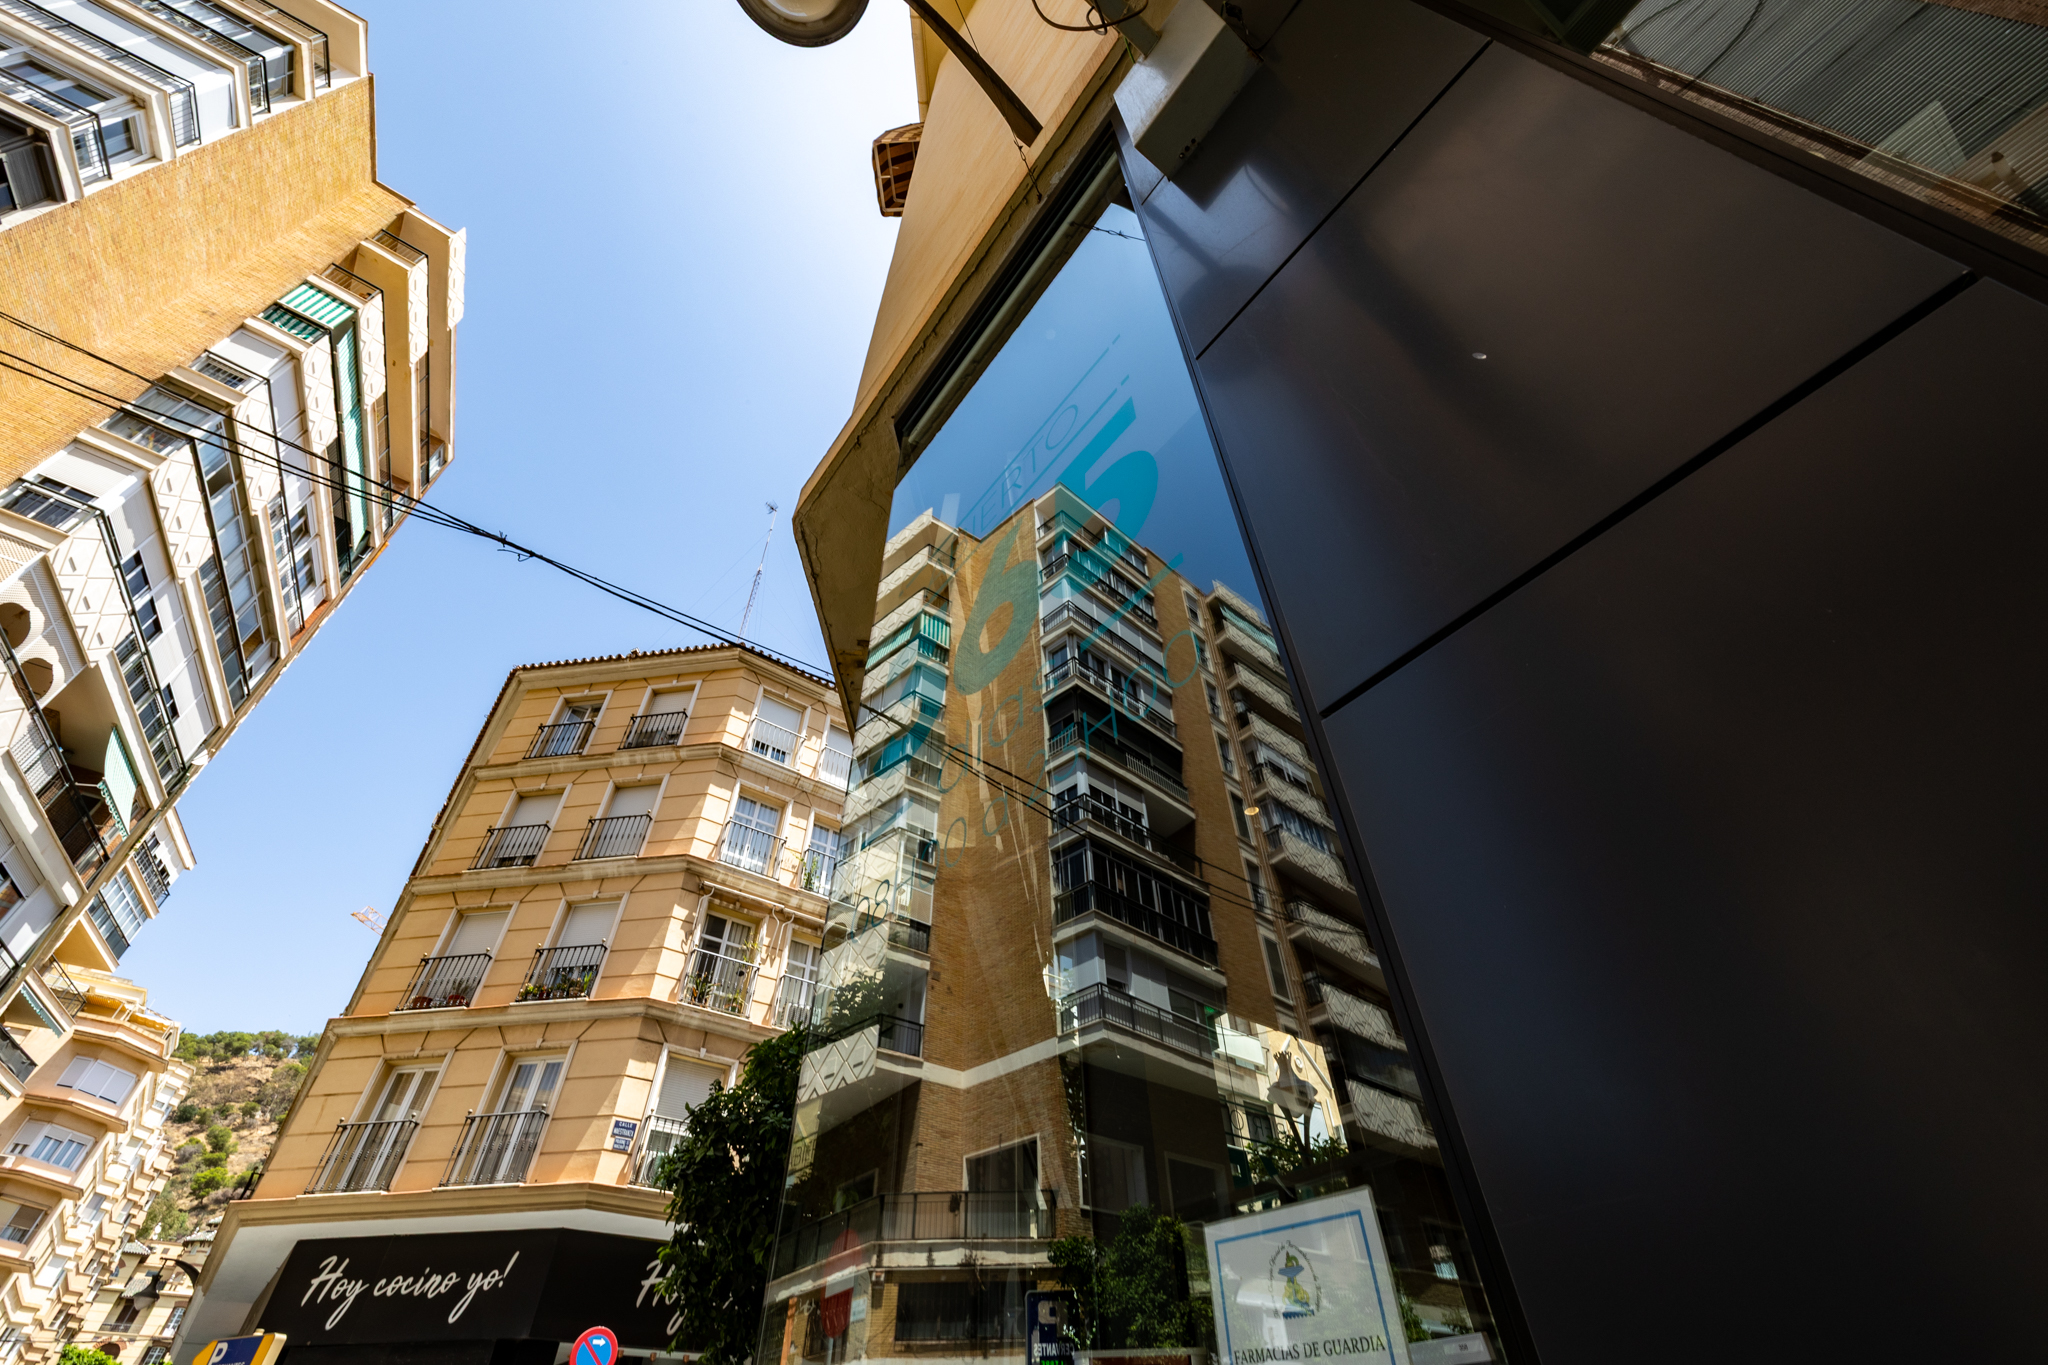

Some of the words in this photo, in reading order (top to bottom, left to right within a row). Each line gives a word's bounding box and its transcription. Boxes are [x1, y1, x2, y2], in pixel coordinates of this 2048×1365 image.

[301, 1255, 369, 1331] Hoy
[373, 1267, 461, 1299] cocino
[448, 1250, 520, 1324] yo!
[1233, 1343, 1300, 1365] FARMACIAS
[1302, 1341, 1321, 1359] DE
[1323, 1335, 1386, 1357] GUARDIA
